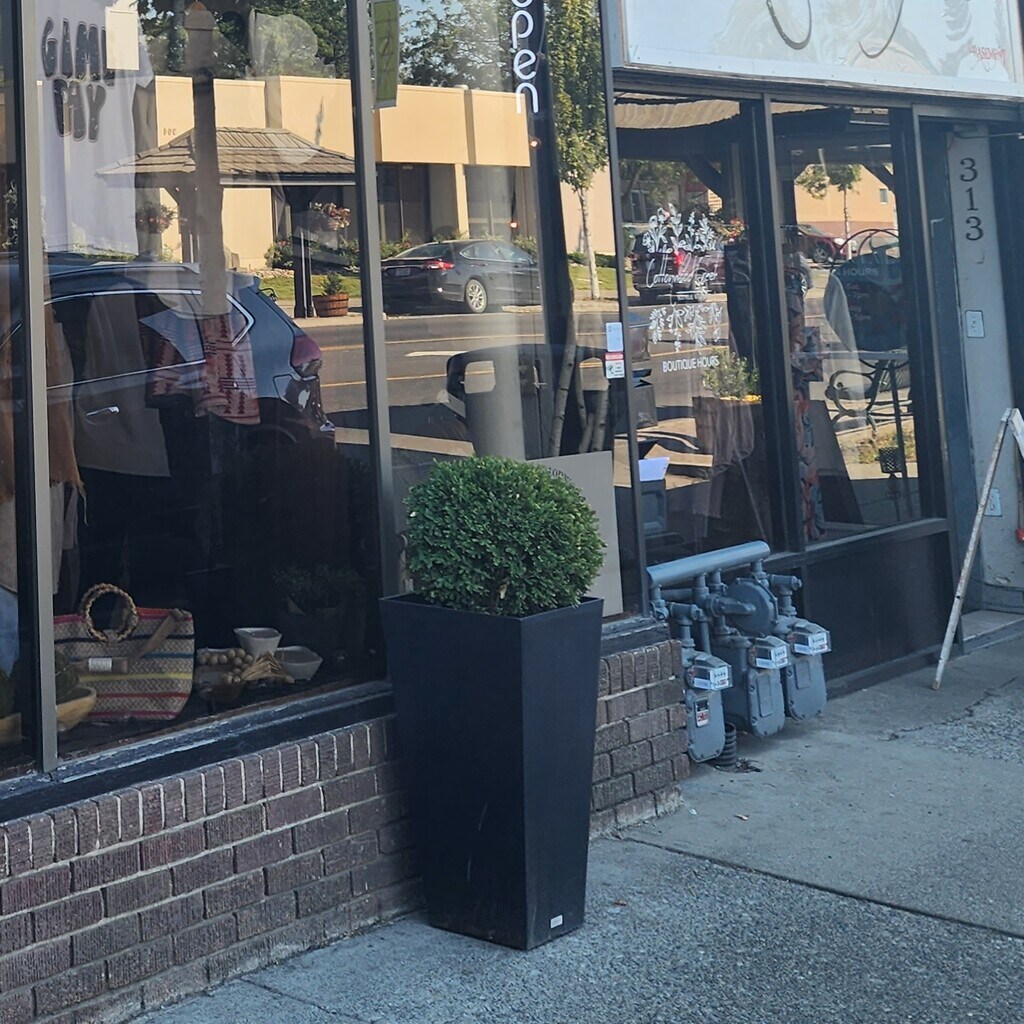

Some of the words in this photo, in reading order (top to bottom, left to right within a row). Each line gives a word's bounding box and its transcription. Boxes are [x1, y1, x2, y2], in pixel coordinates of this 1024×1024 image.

[960, 157, 984, 241] 313
[662, 358, 697, 373] BOUTIQUE
[697, 355, 720, 368] HOURS
